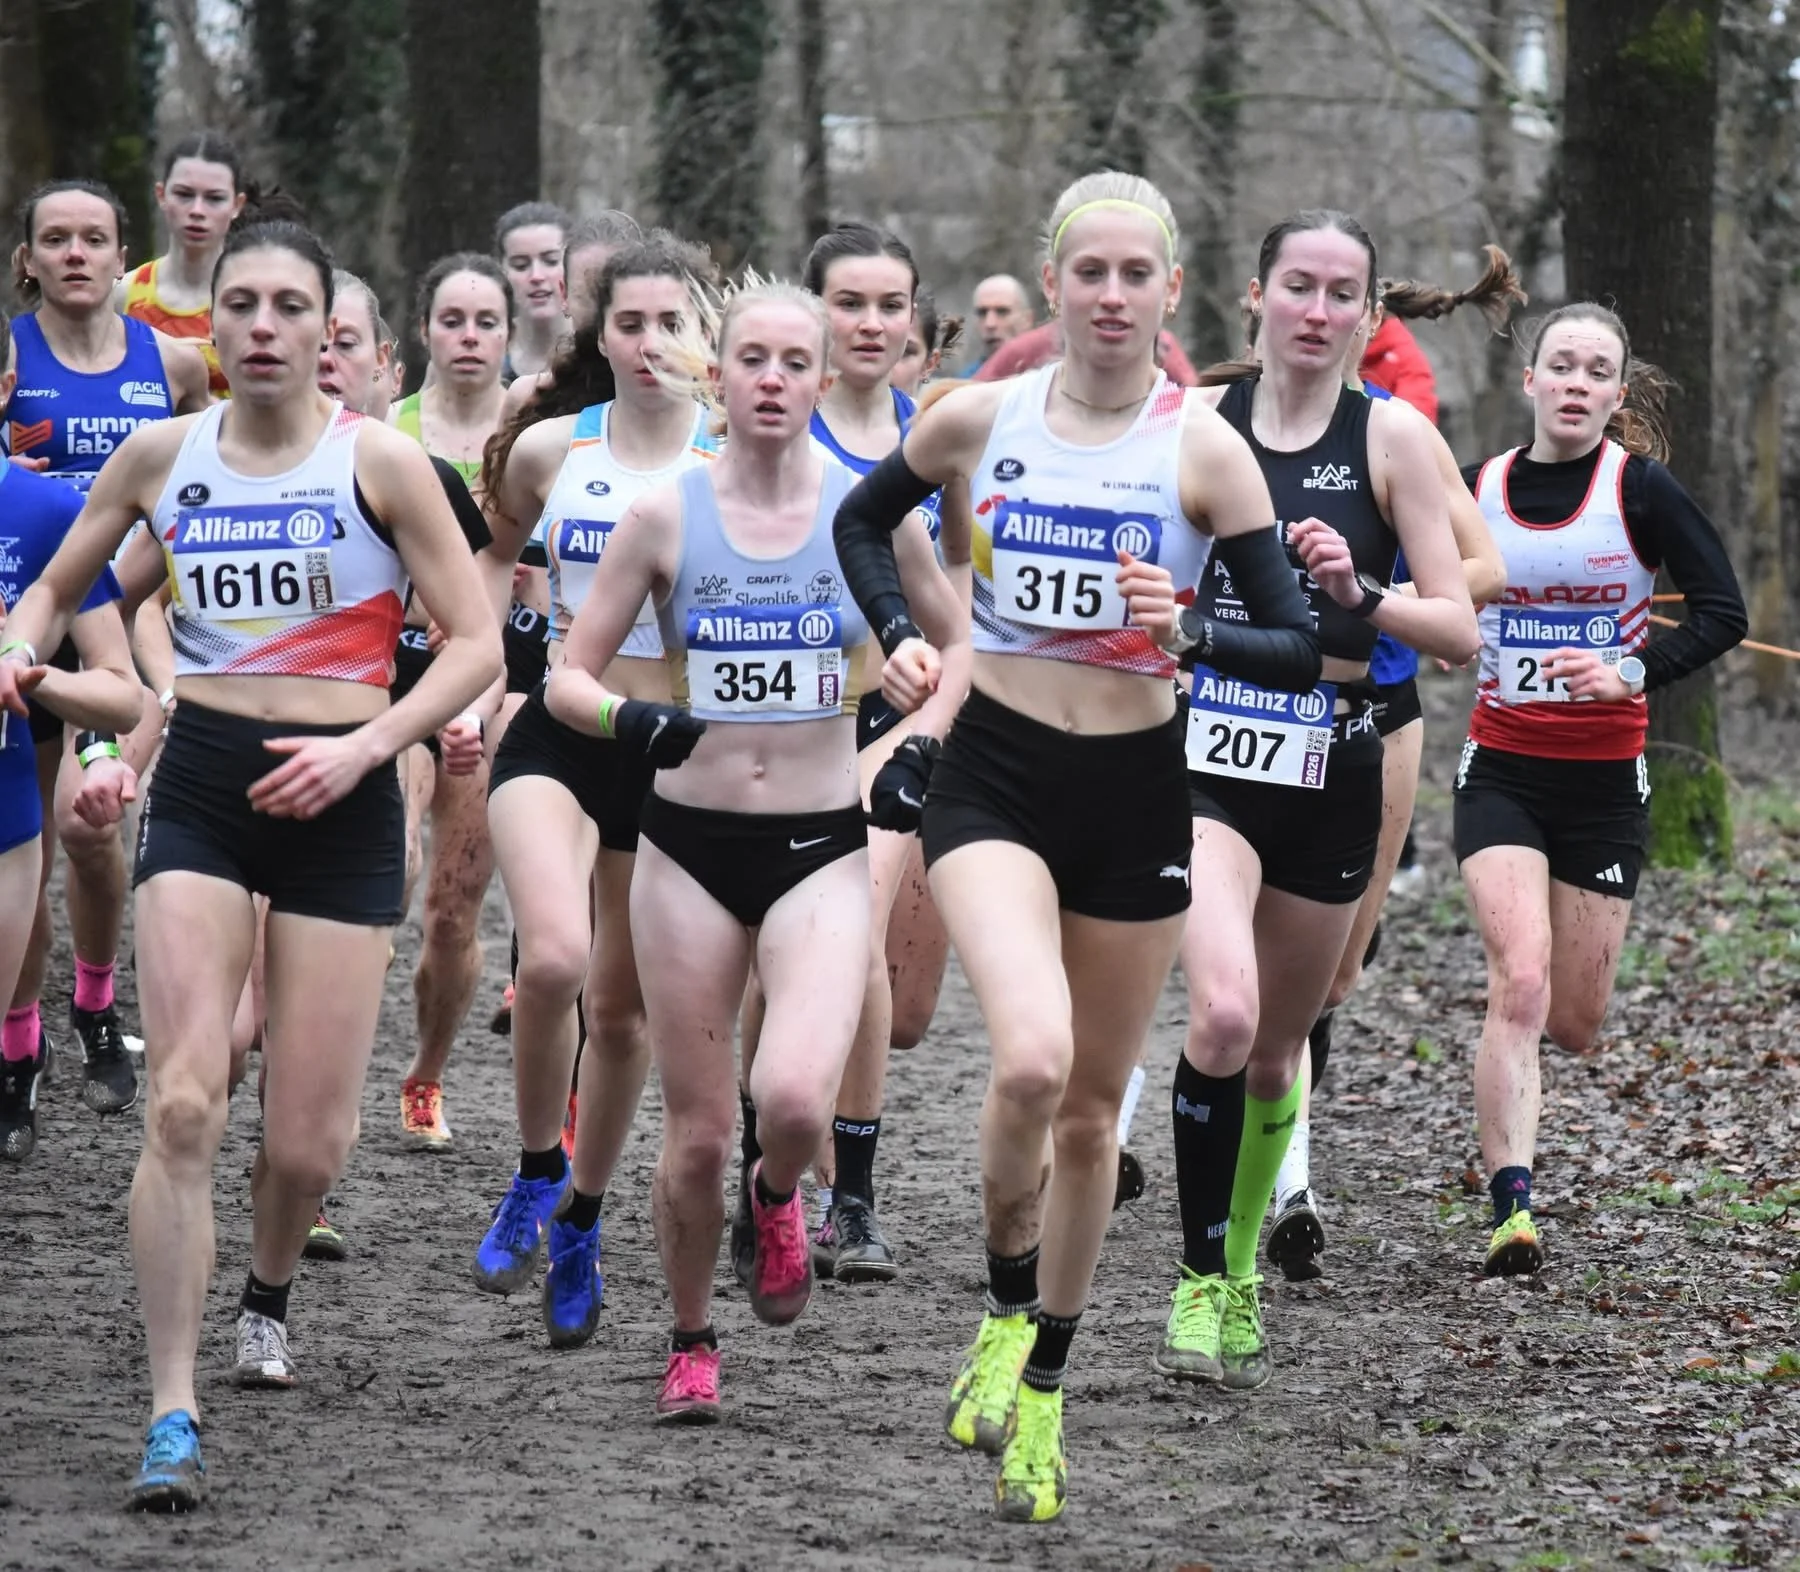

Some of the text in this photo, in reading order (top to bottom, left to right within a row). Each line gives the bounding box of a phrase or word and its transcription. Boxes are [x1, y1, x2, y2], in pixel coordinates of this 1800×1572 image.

[17, 389, 50, 398] CRAFT
[134, 381, 166, 395] ACHL
[66, 433, 114, 455] lab
[182, 516, 281, 544] Allianz
[1001, 511, 1106, 551] Allianz
[187, 560, 300, 609] 1616
[311, 577, 330, 609] 2026
[746, 575, 783, 585] CRAFT
[1014, 565, 1103, 618] 315
[696, 616, 792, 642] Allianz
[1505, 618, 1581, 641] Allianz
[714, 660, 796, 702] 354
[1517, 656, 1570, 693] 21
[822, 675, 834, 706] 2026
[1198, 676, 1289, 713] Allianz
[1206, 723, 1286, 772] 207
[1305, 754, 1320, 785] 2026
